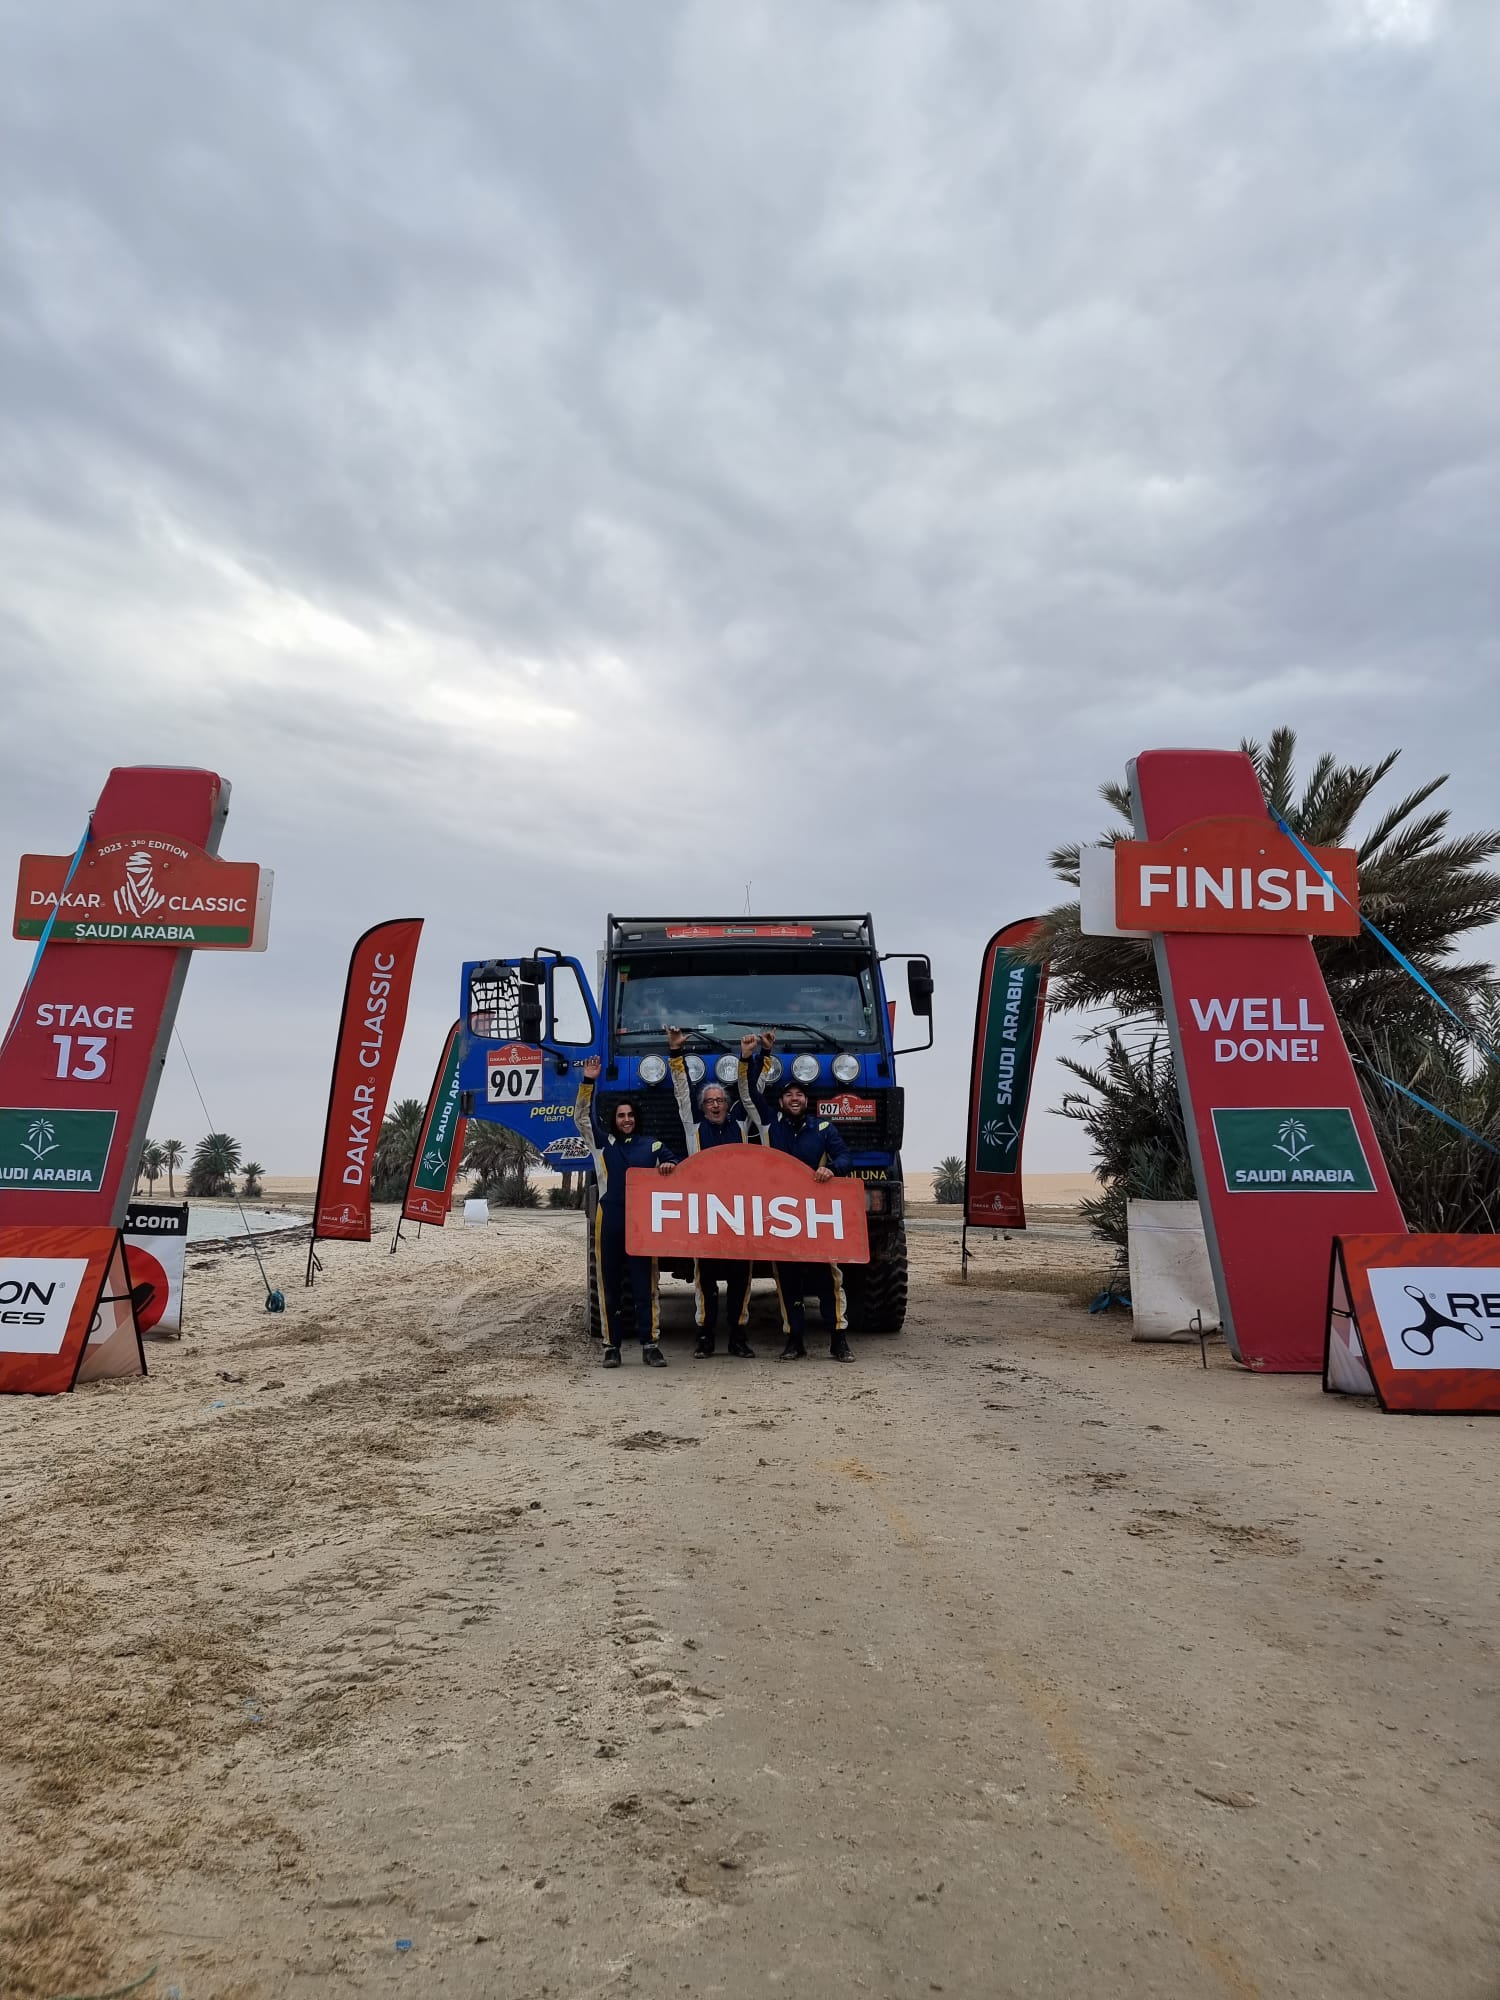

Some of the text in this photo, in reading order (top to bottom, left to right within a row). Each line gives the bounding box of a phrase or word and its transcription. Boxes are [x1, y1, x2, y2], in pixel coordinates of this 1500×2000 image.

[98, 842, 122, 857] 2023
[148, 840, 189, 859] EDITION
[30, 890, 248, 913] DAKAR CLASSIC
[1140, 864, 1335, 912] FINISH
[75, 923, 195, 940] SAUDI ARABIA
[35, 1003, 135, 1030] STAGE
[1189, 998, 1325, 1032] WELL
[997, 967, 1025, 1105] SAUDI ARABIA
[53, 1034, 108, 1080] 13
[1214, 1038, 1319, 1063] DONE!
[342, 1084, 375, 1185] DAKAR
[359, 952, 395, 1068] CLASSIC
[491, 1069, 540, 1097] 907
[436, 1101, 454, 1142] SAUDI
[543, 1114, 565, 1122] team
[820, 1103, 838, 1114] 907
[32, 1168, 92, 1182] ARABIA
[1235, 1169, 1355, 1183] SAUDI ARABIA
[651, 1191, 844, 1240] FINISH
